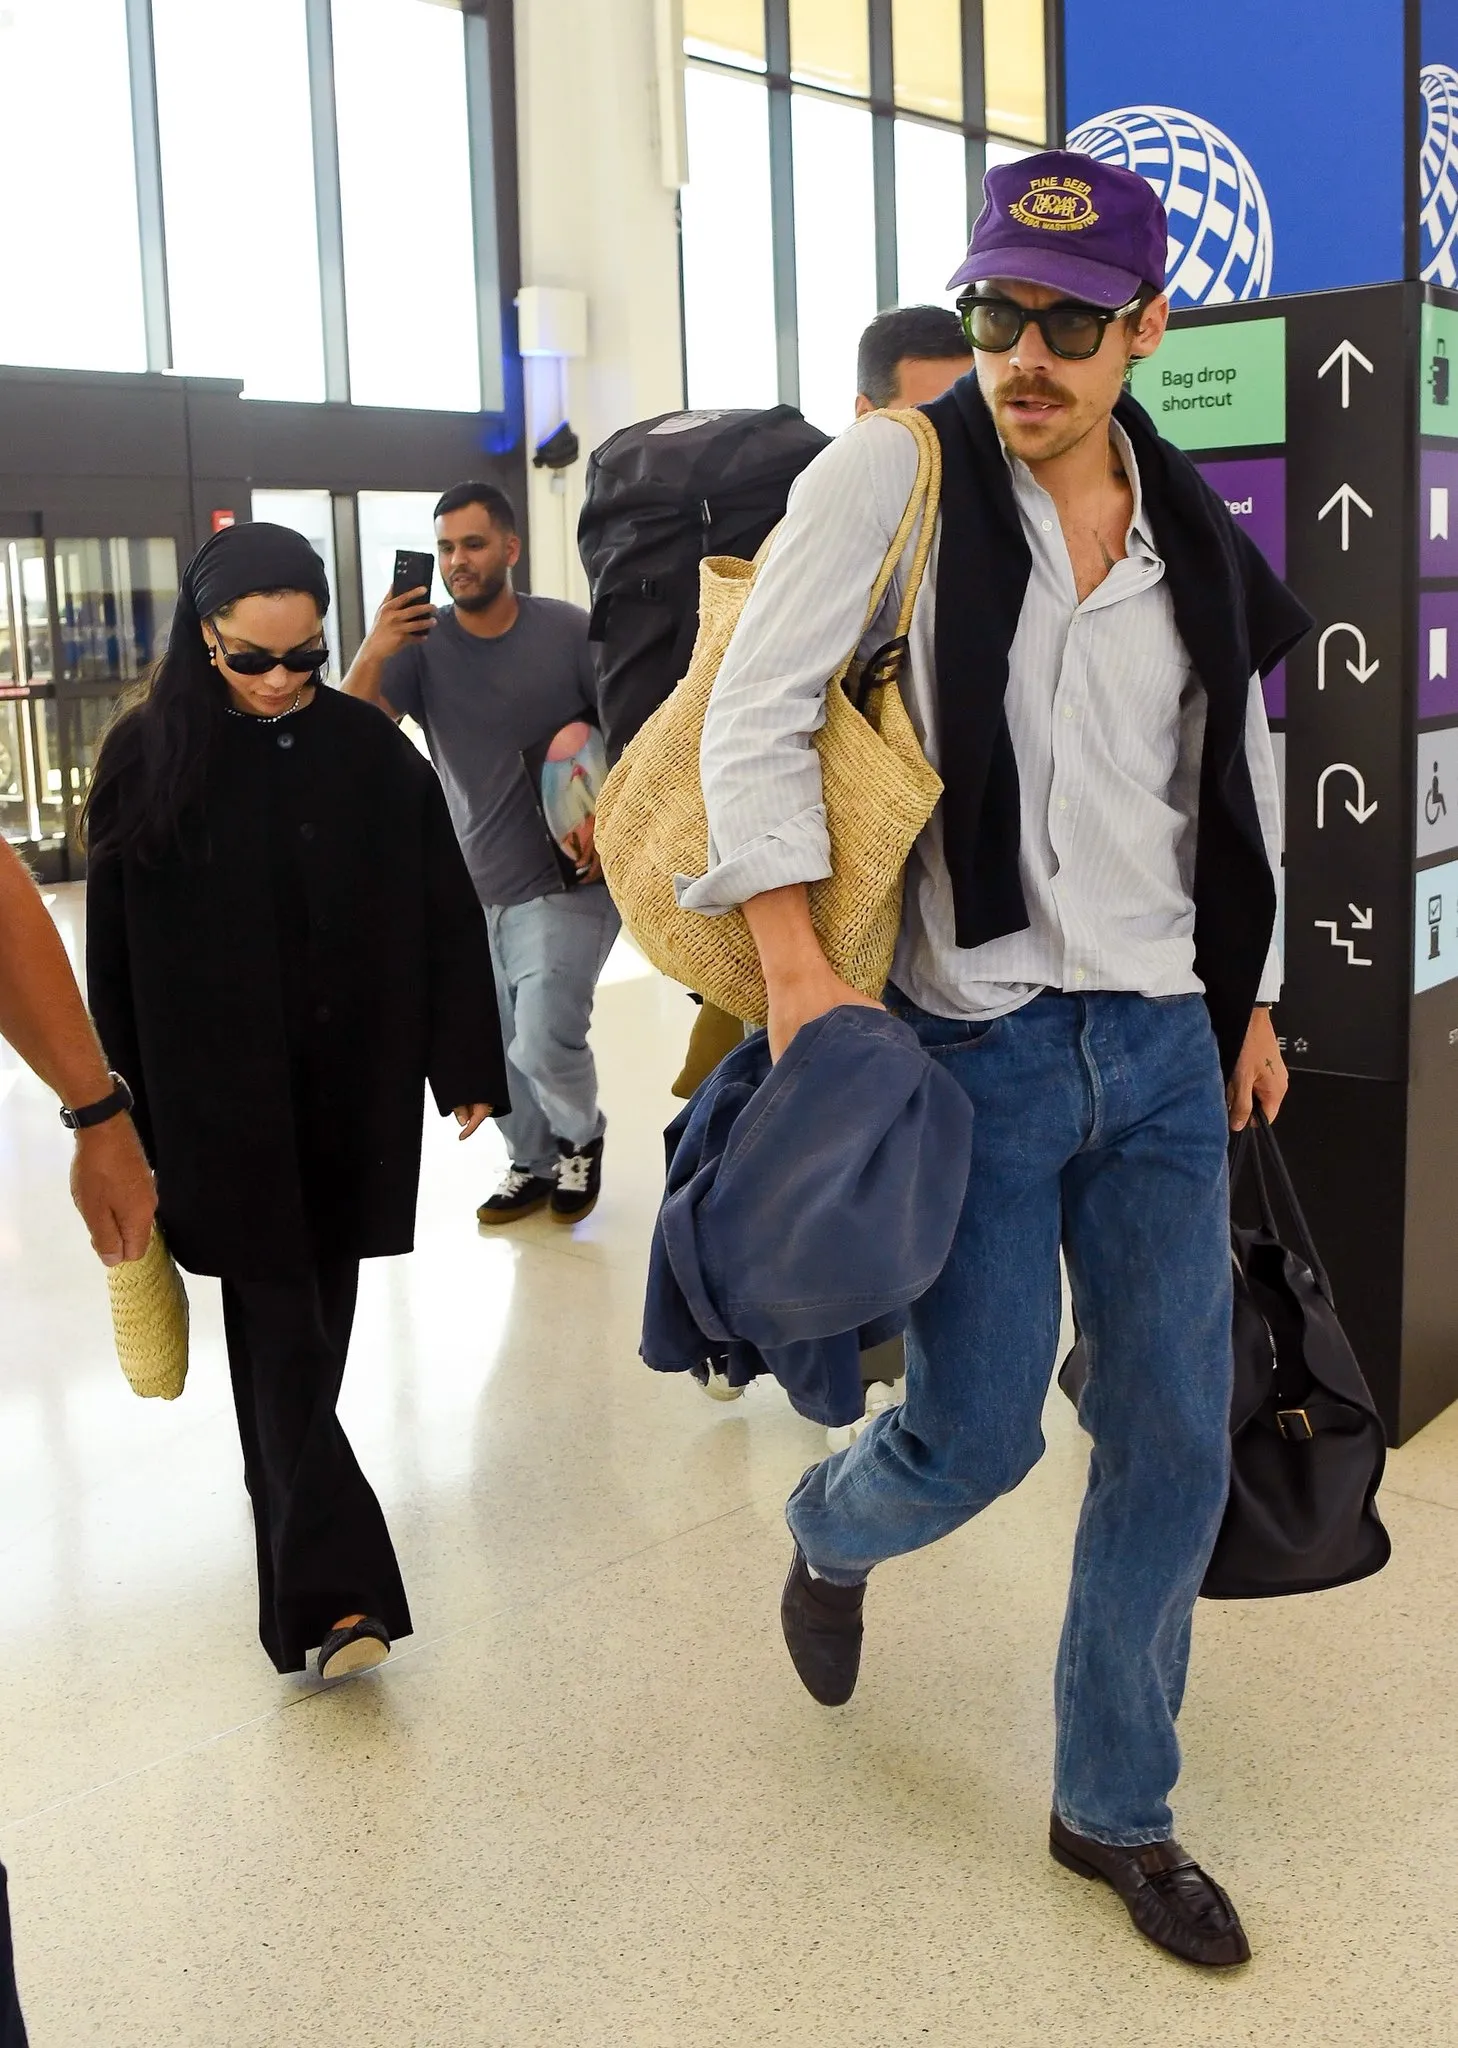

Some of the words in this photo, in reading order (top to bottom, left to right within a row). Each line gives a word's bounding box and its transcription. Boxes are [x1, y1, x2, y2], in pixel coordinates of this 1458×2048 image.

[1030, 176, 1058, 190] FINE
[1063, 177, 1092, 195] BEER
[1042, 211, 1100, 231] WASHINGTON
[1162, 370, 1193, 388] Bag
[1197, 367, 1237, 385] drop
[1162, 392, 1232, 412] shortcut
